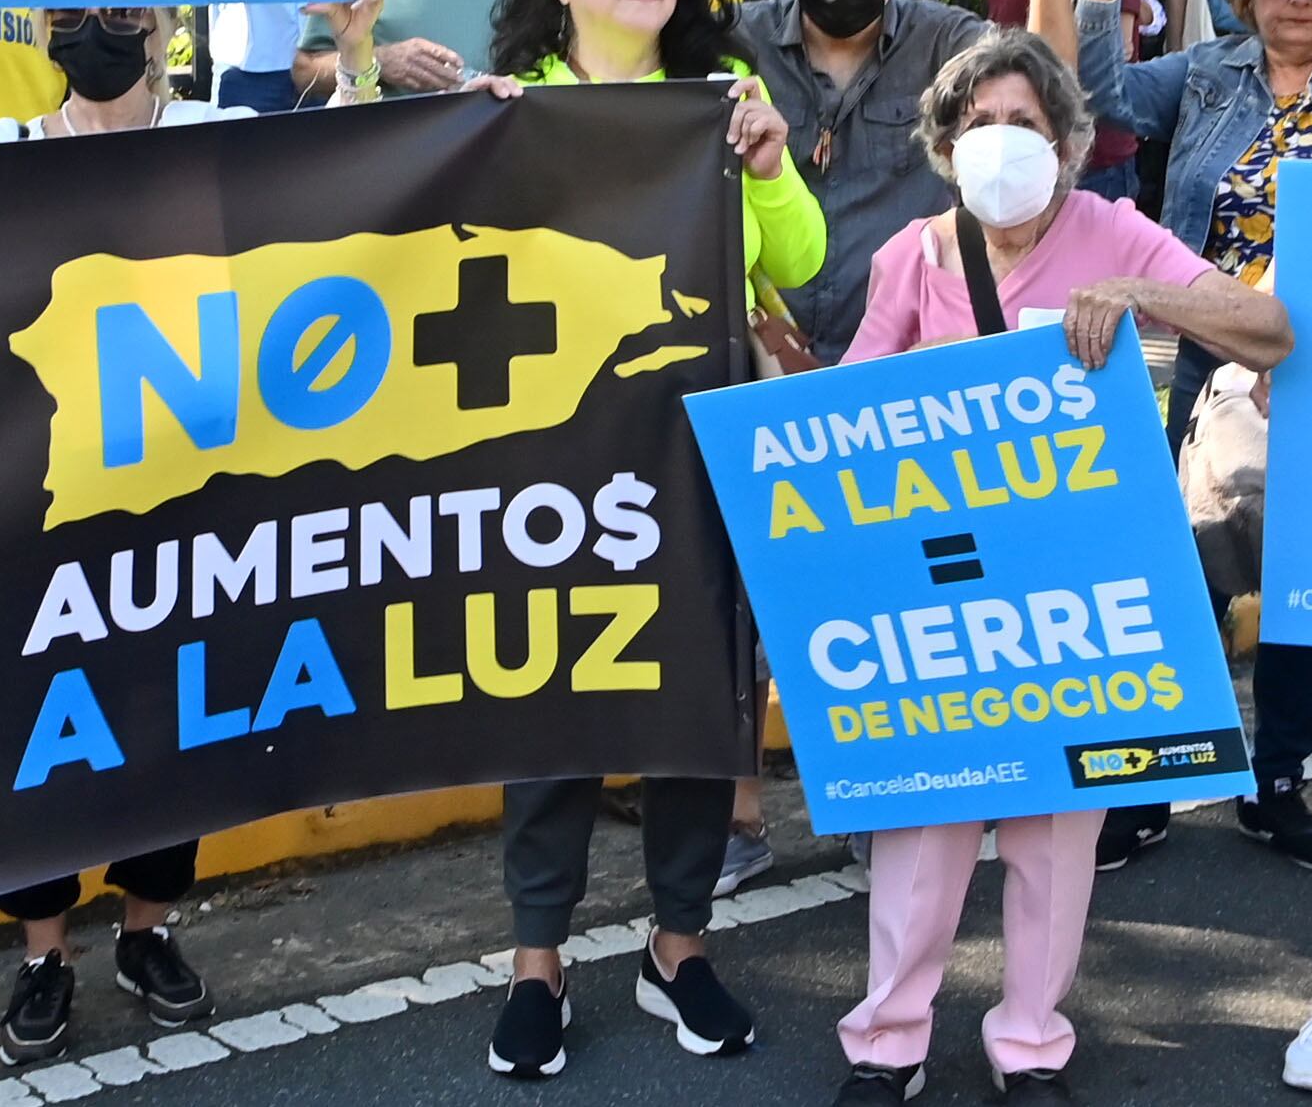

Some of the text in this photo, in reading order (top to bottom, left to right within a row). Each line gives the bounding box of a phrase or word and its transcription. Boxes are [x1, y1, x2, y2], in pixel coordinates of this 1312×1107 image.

[767, 424, 1118, 540] A LA LUZ
[808, 577, 1163, 692] CIERRE
[13, 584, 661, 791] A LA LUZ
[826, 701, 896, 743] DE
[825, 761, 1028, 800] #CancelaDeudaAEE
[1160, 752, 1216, 767] A LA LUZ
